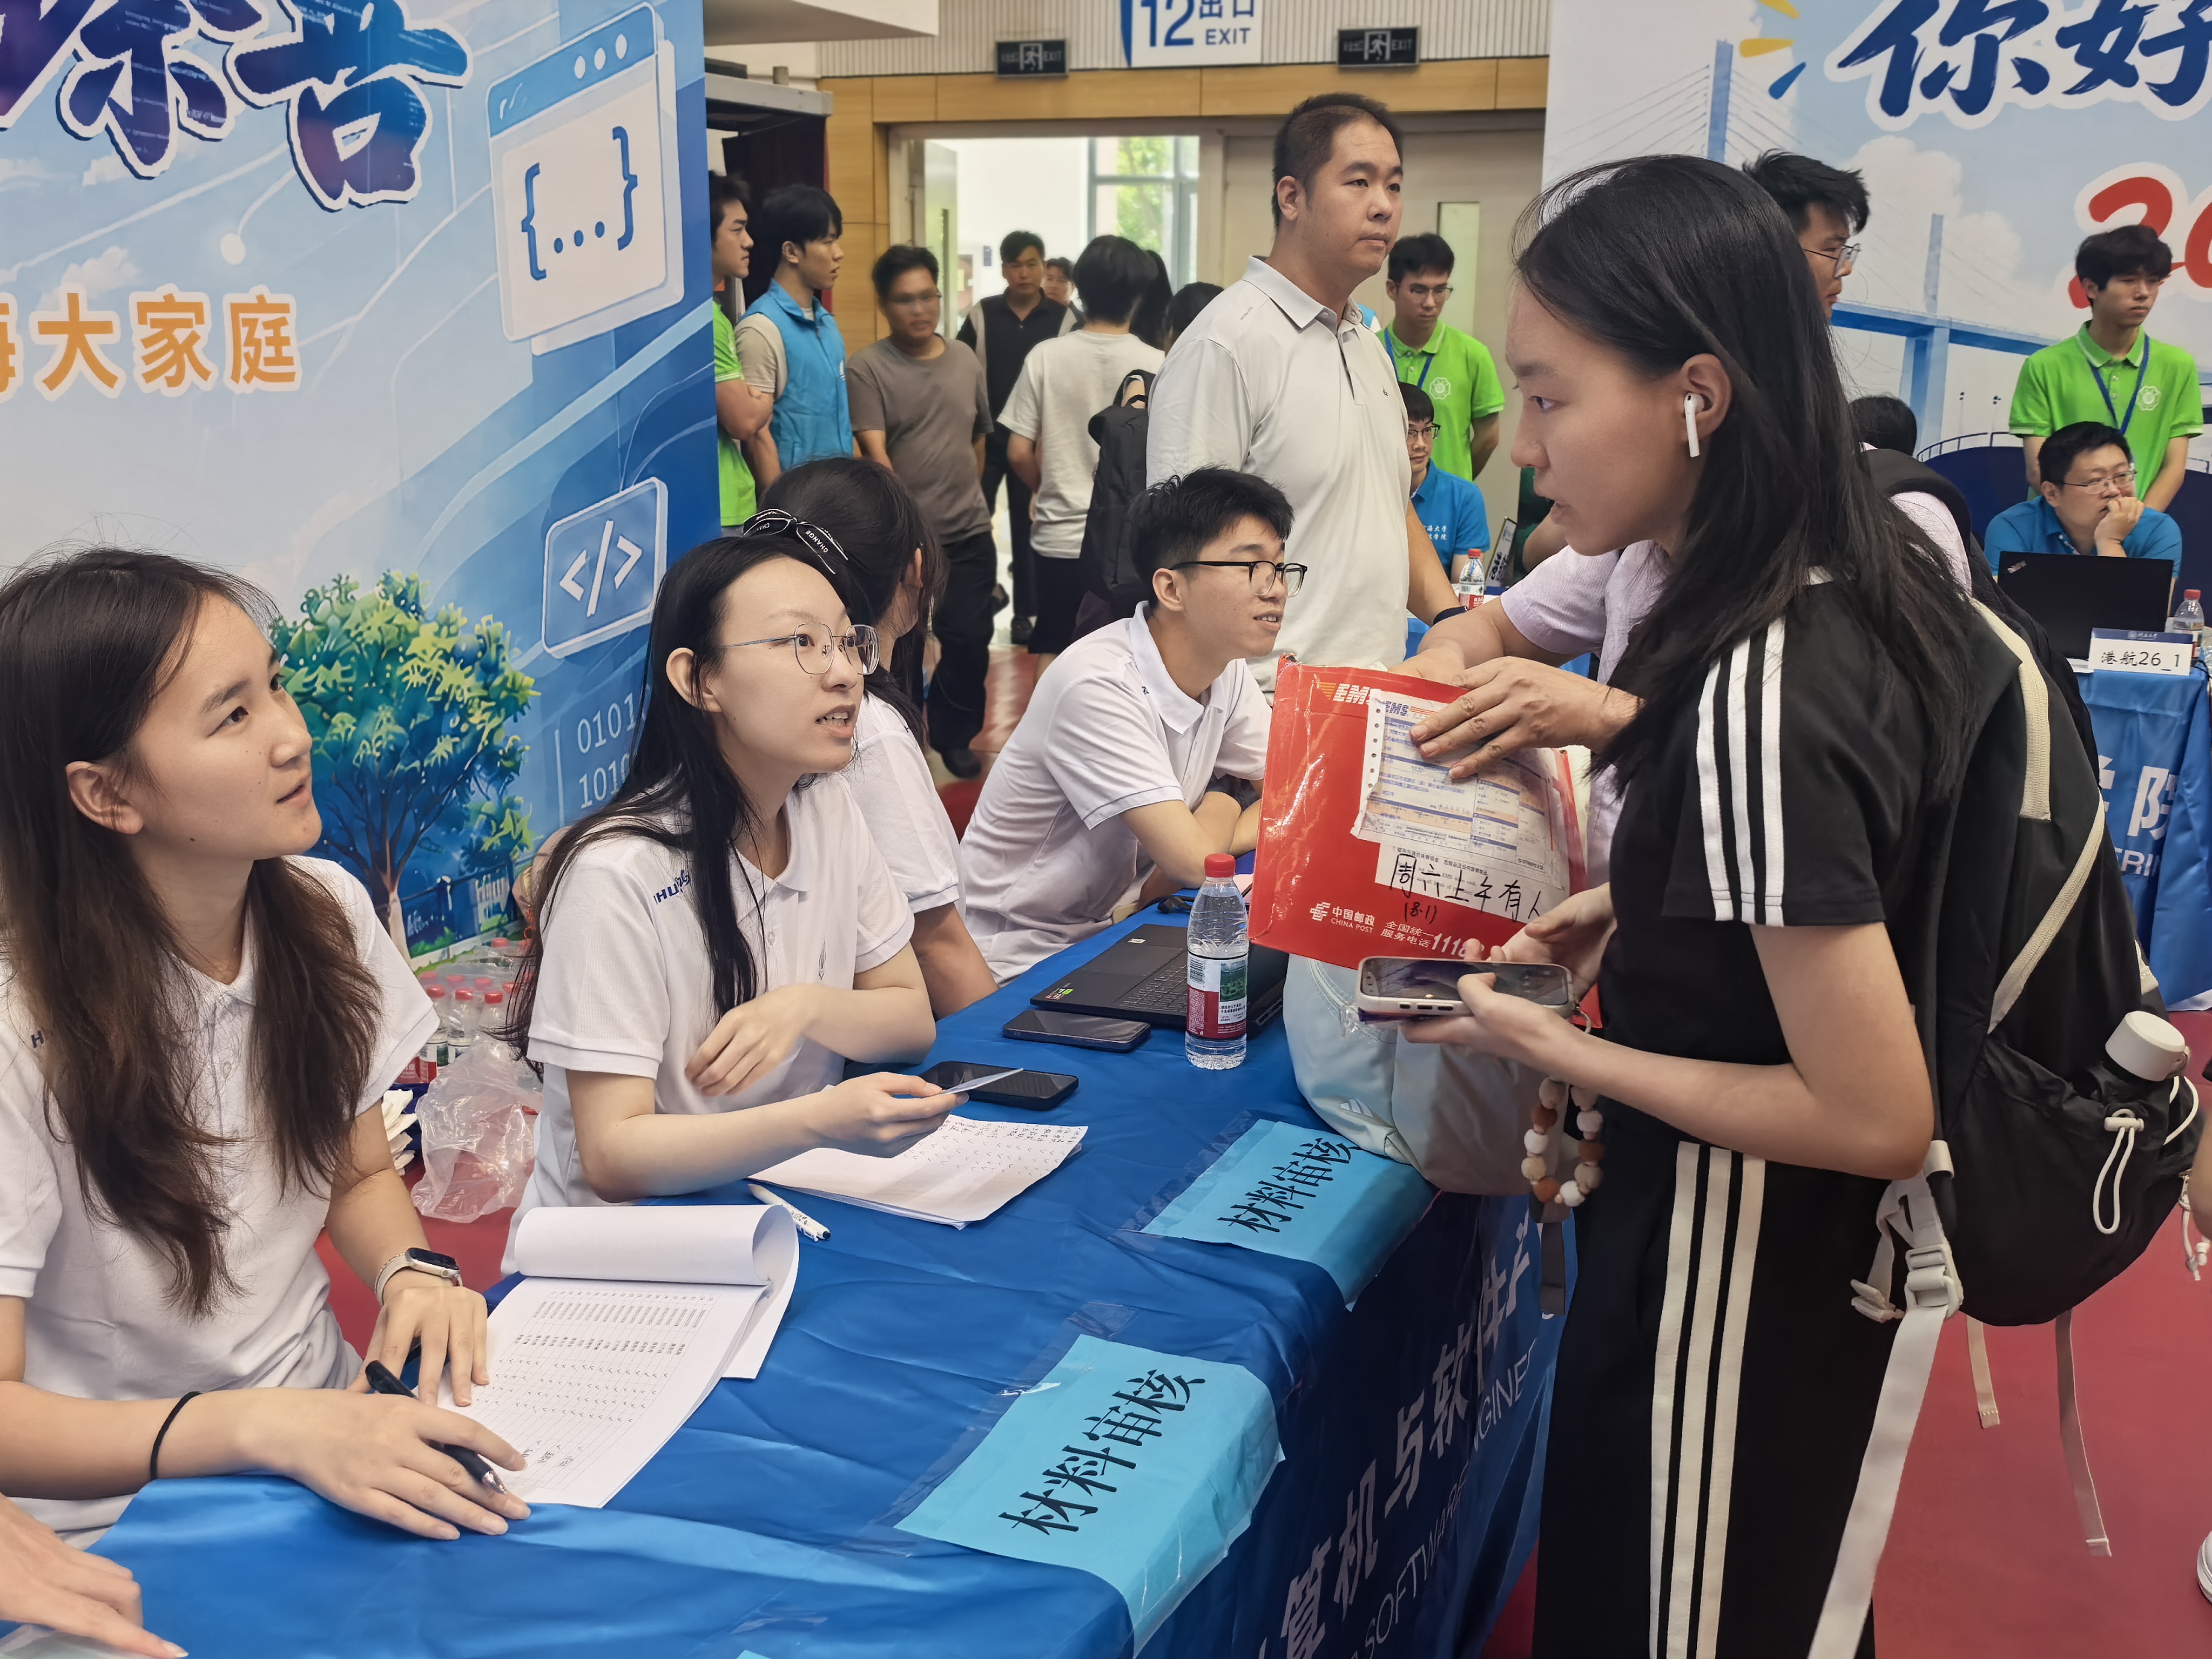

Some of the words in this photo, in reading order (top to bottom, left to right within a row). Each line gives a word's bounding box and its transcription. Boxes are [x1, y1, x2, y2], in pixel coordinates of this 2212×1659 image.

[1141, 0, 1195, 47] 12
[1205, 27, 1251, 45] EXIT
[0, 292, 297, 393] 大家庭
[1424, 524, 1447, 533] 海大学
[1332, 683, 1371, 705] EM
[1390, 853, 1541, 922] 周六上午有人
[1330, 917, 1354, 929] CHINA
[1355, 922, 1374, 934] POST
[1332, 906, 1375, 928] 中国邮政
[1380, 928, 1432, 948] 服务电话
[1386, 920, 1435, 938] 全国统一
[1216, 1137, 1362, 1233] 材料审核
[998, 1369, 1206, 1535] 材料审核
